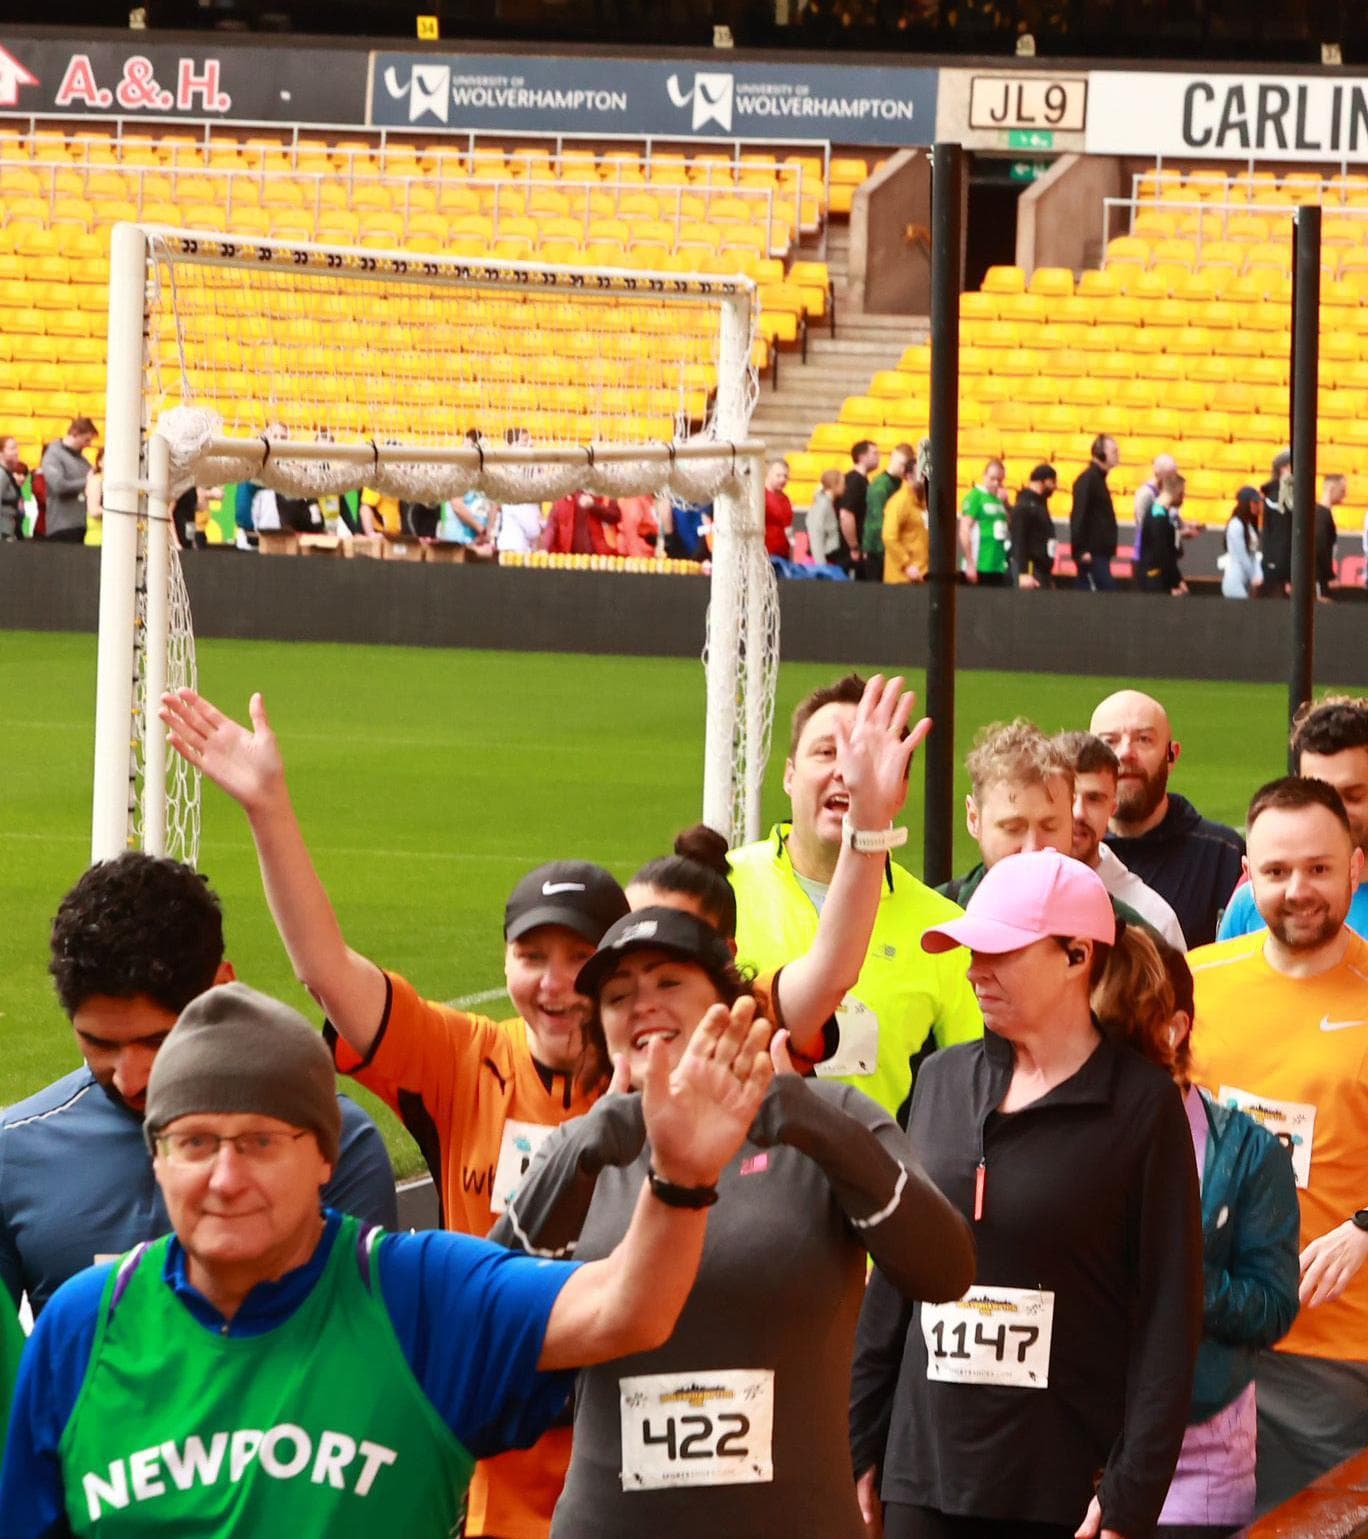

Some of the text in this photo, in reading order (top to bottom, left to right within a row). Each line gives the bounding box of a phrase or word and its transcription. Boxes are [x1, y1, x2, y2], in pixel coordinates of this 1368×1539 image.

[453, 75, 525, 87] UNIVERSITY OF
[736, 84, 793, 95] UNIVERSITY
[452, 87, 628, 112] WOLVERHAMPTON
[735, 95, 914, 120] WOLVERHAMPTON
[990, 86, 1067, 124] JL9
[931, 1319, 1040, 1363] 1147
[642, 1413, 750, 1461] 422
[82, 1423, 398, 1522] NEWPORT
